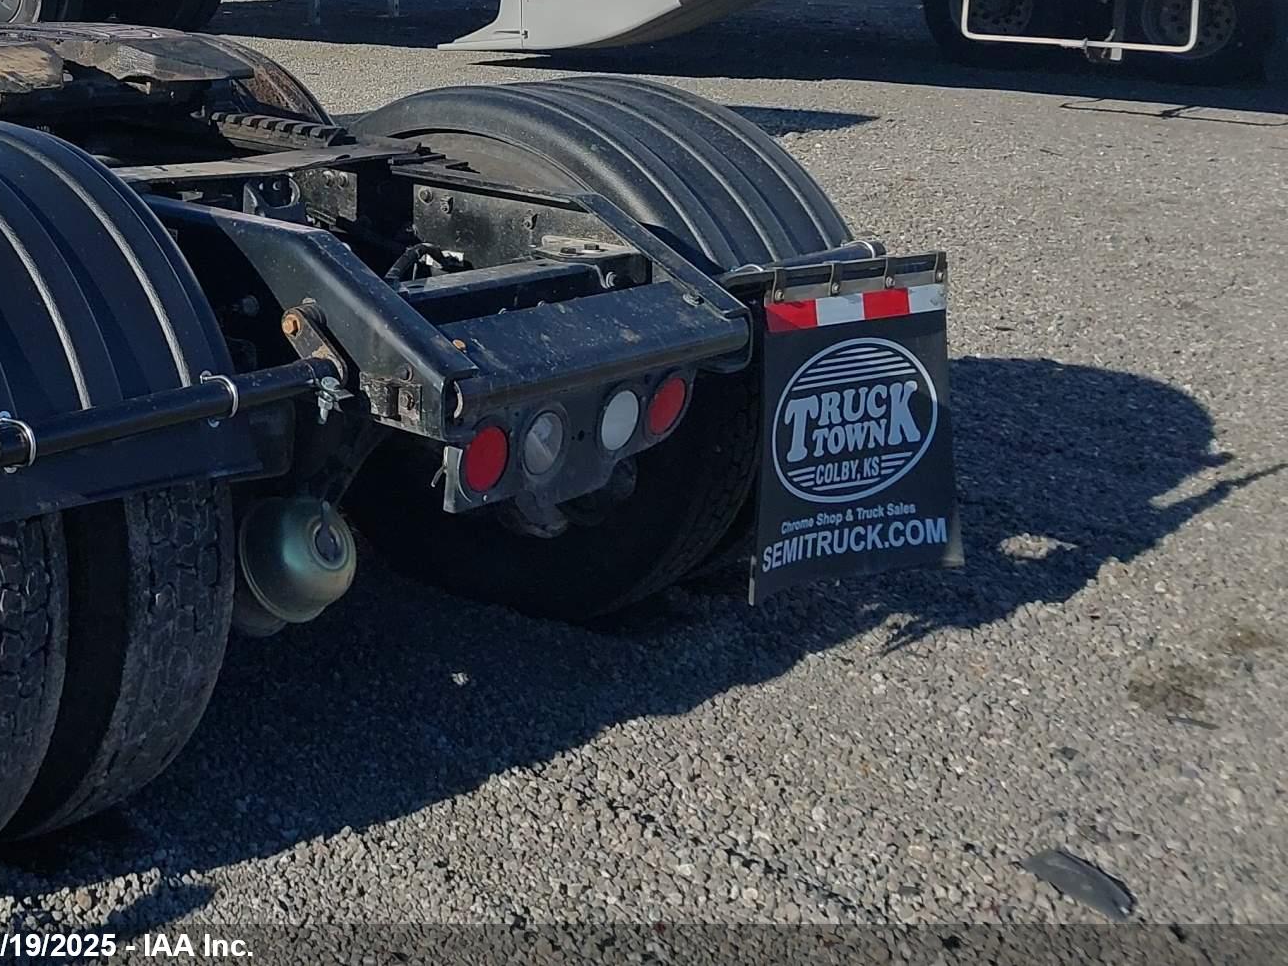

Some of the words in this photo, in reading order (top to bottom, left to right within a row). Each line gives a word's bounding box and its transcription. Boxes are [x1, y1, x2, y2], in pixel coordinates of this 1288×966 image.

[784, 380, 921, 463] TRUCK
[813, 418, 887, 458] TOWN
[815, 460, 861, 485] COLBY,
[863, 456, 880, 478] KS
[781, 516, 815, 535] Chrome
[816, 511, 843, 527] Shop
[845, 508, 854, 522] &
[856, 504, 885, 521] Truck
[886, 501, 917, 517] Sales
[762, 517, 948, 573] SEMITRUCK.COM
